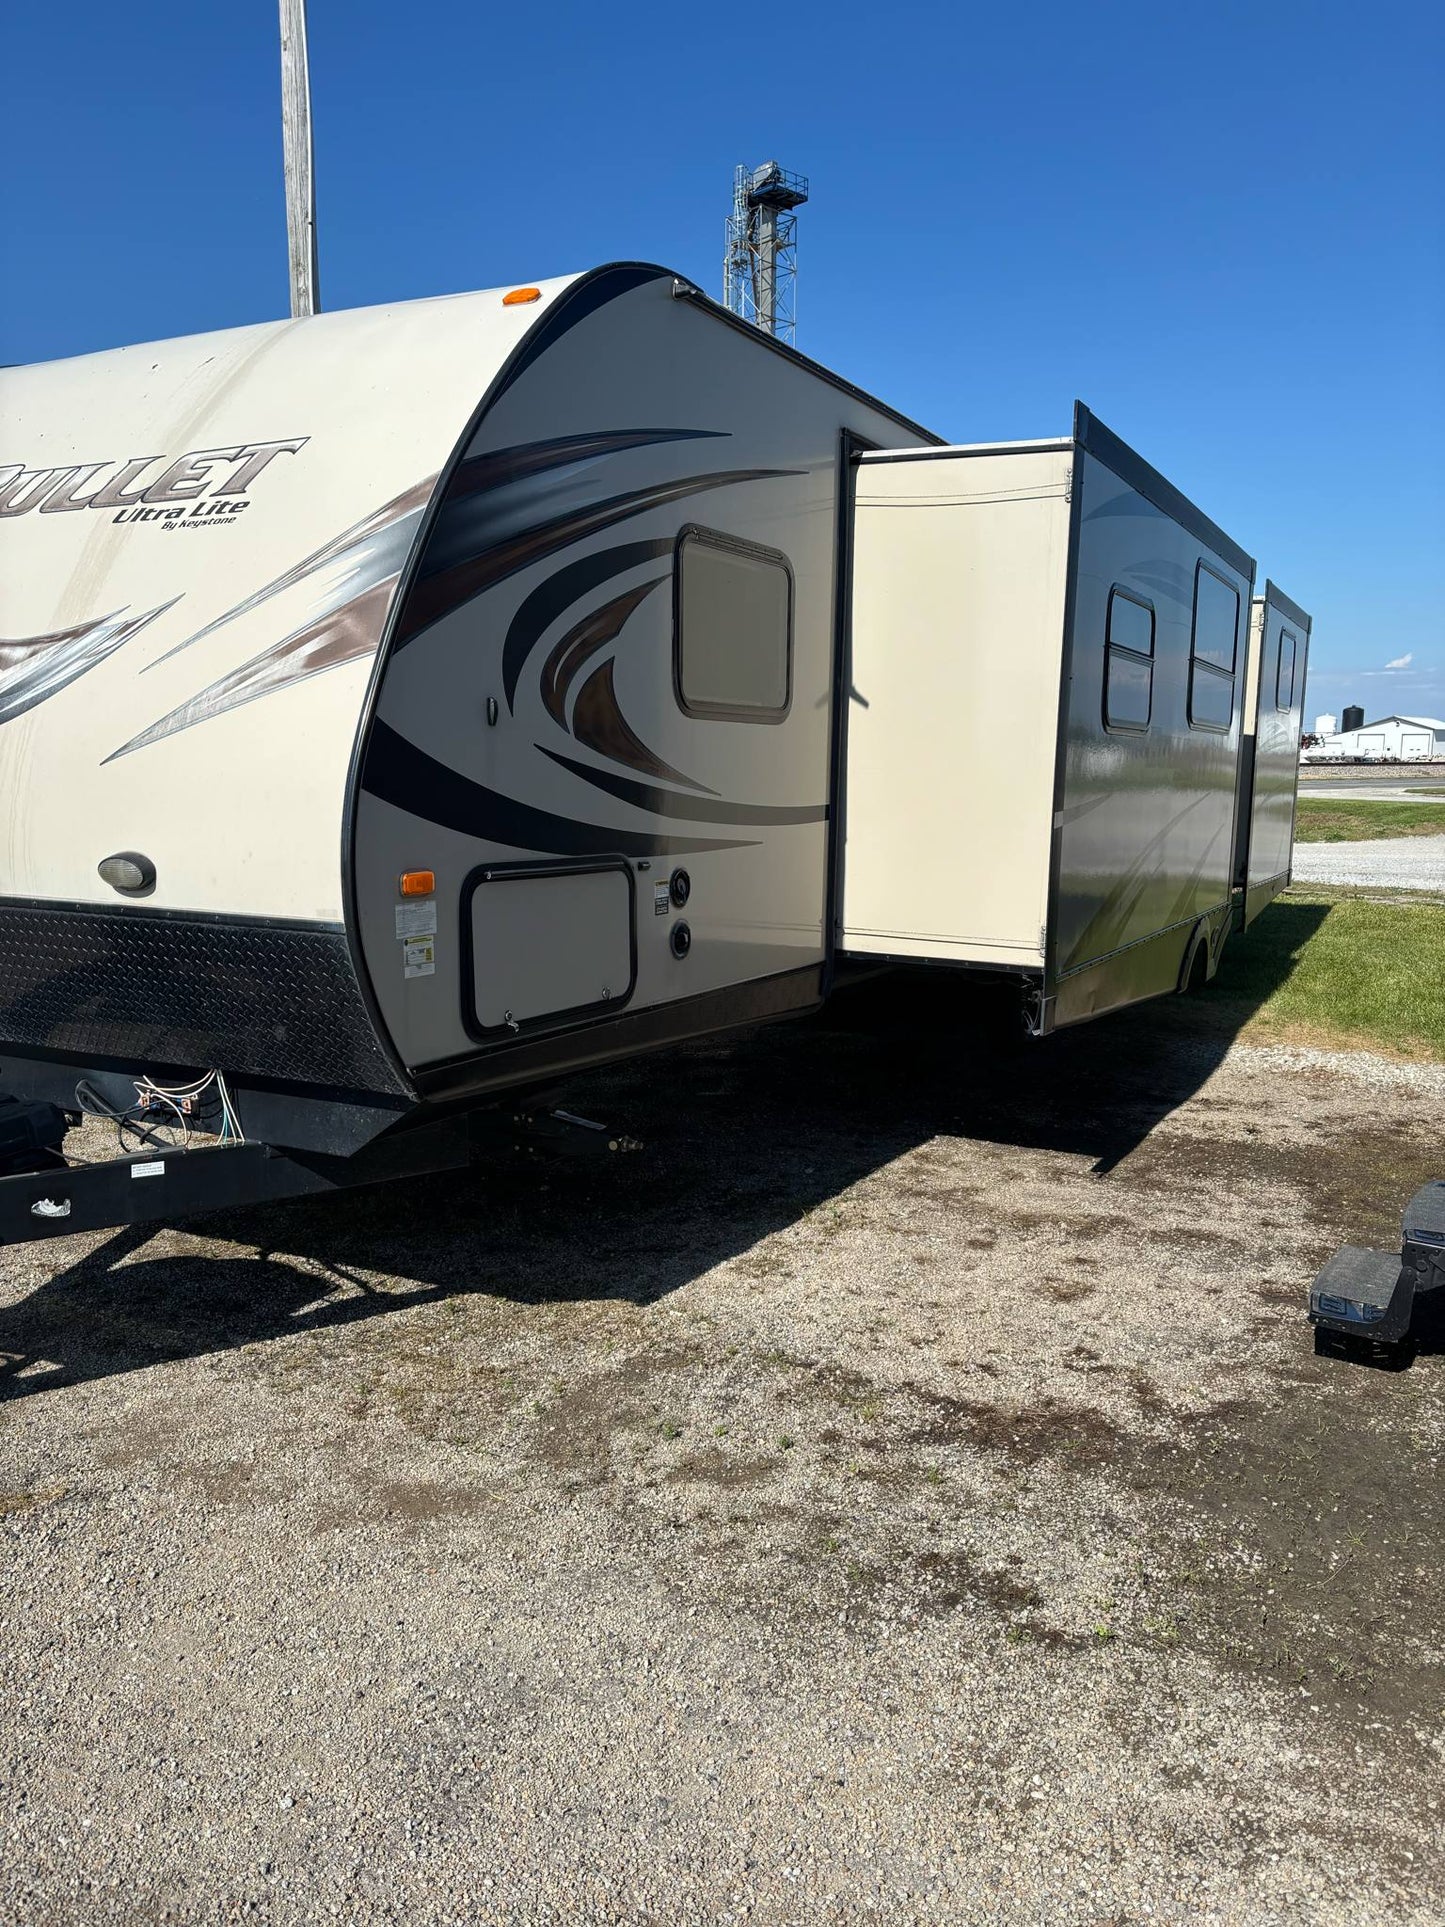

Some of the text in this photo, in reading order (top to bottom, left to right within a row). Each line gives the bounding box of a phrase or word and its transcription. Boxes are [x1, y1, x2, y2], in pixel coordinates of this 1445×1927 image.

[112, 500, 251, 524] Ultra Lite
[160, 516, 237, 531] By Keystone
